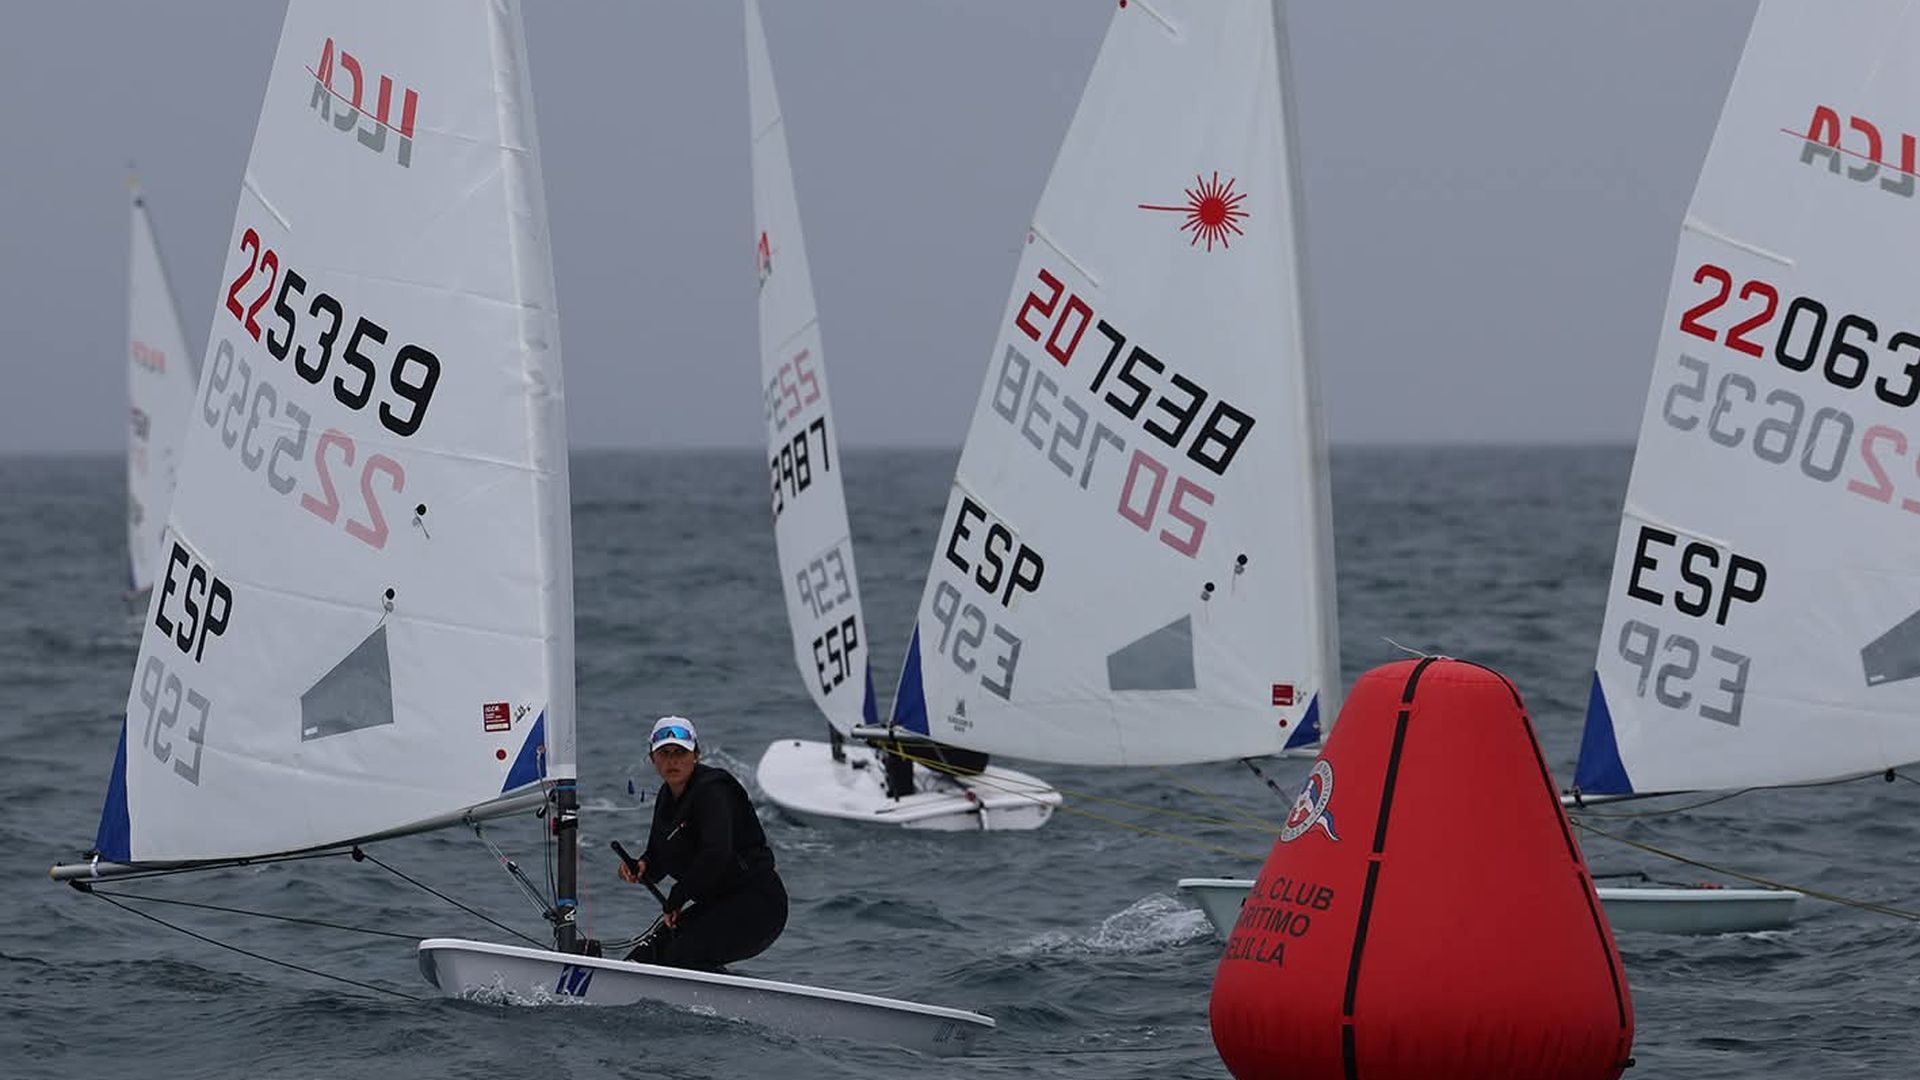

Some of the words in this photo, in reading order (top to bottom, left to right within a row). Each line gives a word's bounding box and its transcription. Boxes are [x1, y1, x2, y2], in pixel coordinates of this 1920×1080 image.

[225, 227, 441, 437] 225359
[1015, 268, 1256, 476] 207538
[1679, 264, 1920, 408] 22063
[771, 416, 830, 520] 3987
[155, 541, 232, 663] ESP
[946, 496, 1044, 608] ESP
[1627, 526, 1767, 626] ESP
[812, 614, 857, 695] ESP
[1270, 877, 1334, 911] CLUB
